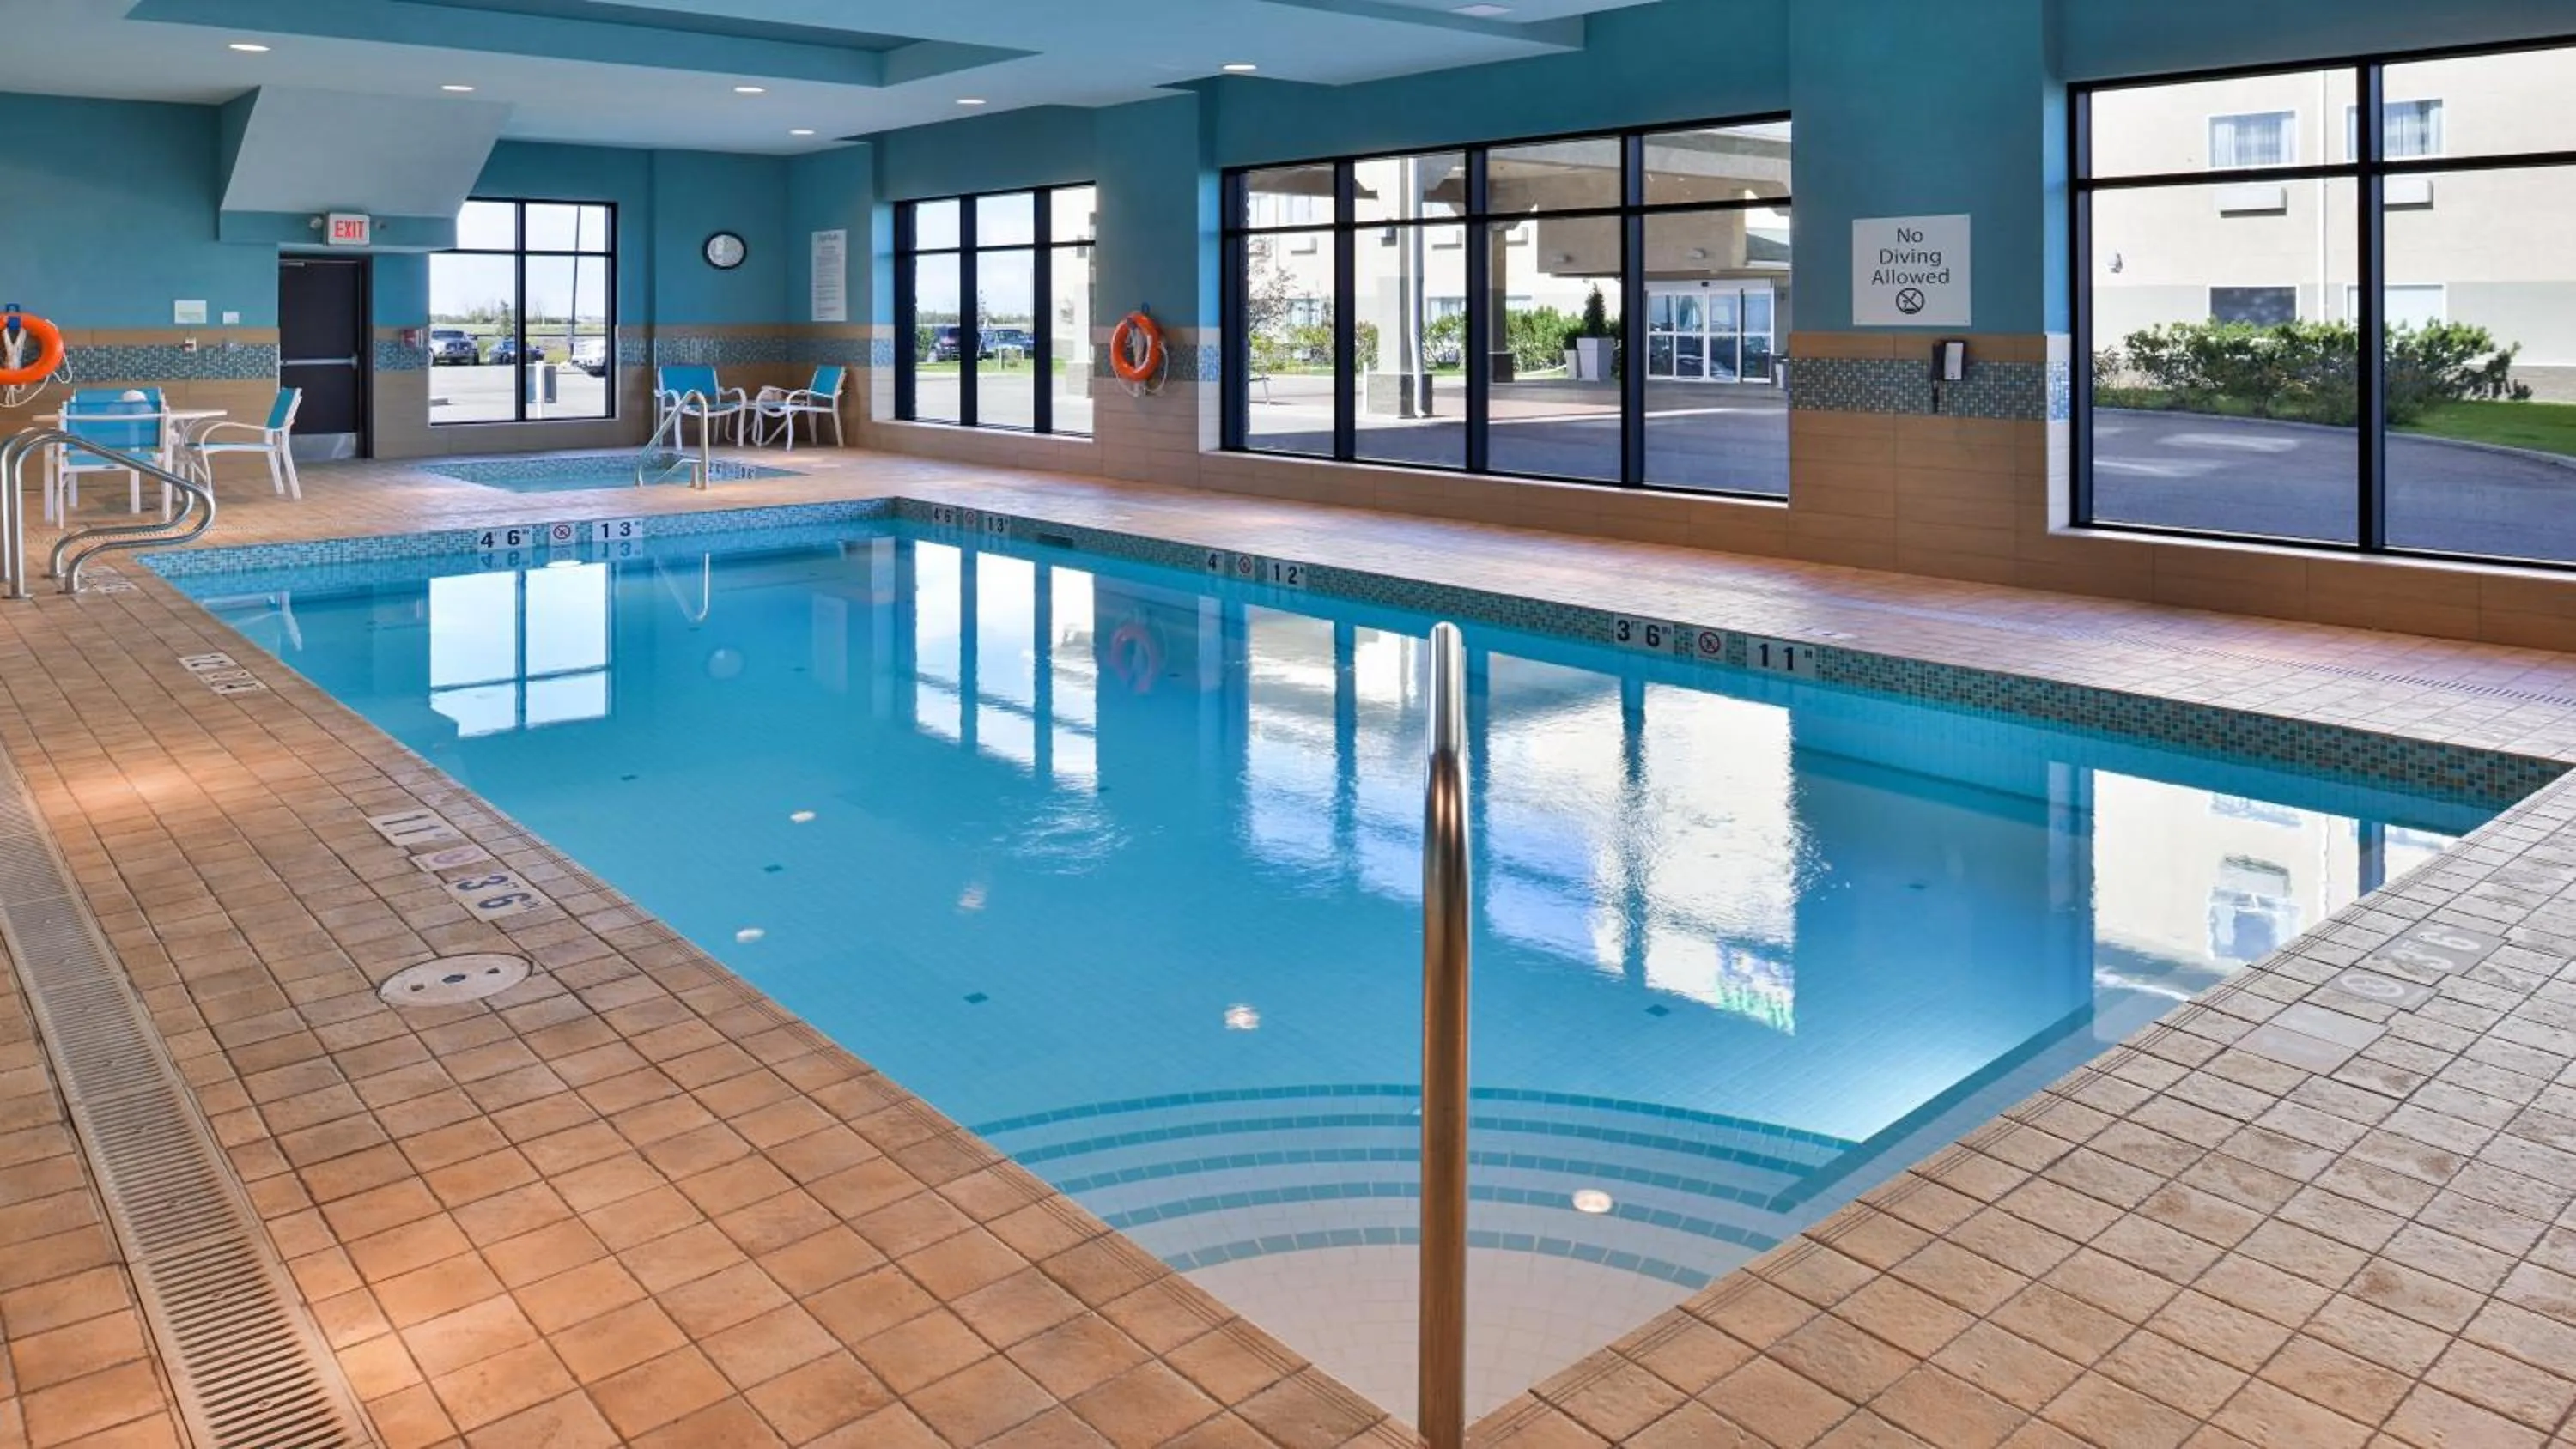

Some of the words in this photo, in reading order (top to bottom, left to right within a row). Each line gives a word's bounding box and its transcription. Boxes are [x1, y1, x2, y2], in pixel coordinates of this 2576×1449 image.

[335, 219, 365, 239] EXIT
[1897, 228, 1923, 243] No
[1880, 248, 1941, 267] Diving
[1872, 268, 1950, 285] Allowed
